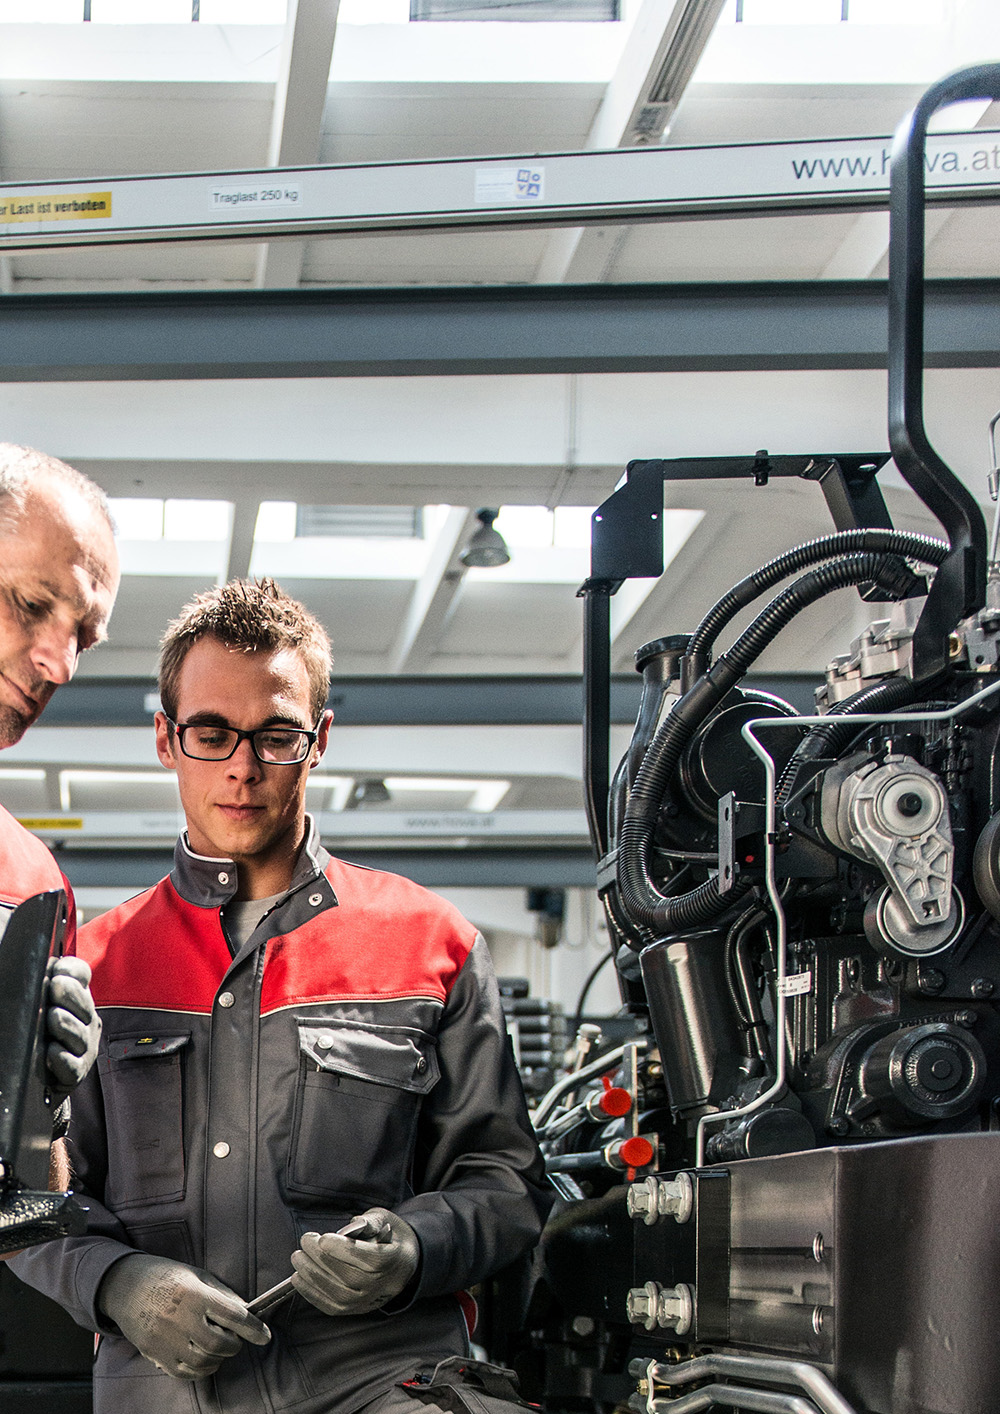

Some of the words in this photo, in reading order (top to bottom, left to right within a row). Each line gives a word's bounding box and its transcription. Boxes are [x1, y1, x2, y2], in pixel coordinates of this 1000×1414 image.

[792, 144, 1000, 180] www.hva.at
[213, 192, 257, 204] Traglast
[260, 189, 282, 201] 250
[284, 189, 299, 201] kg
[10, 202, 35, 216] Last
[36, 200, 51, 214] ist
[53, 198, 107, 214] verboten
